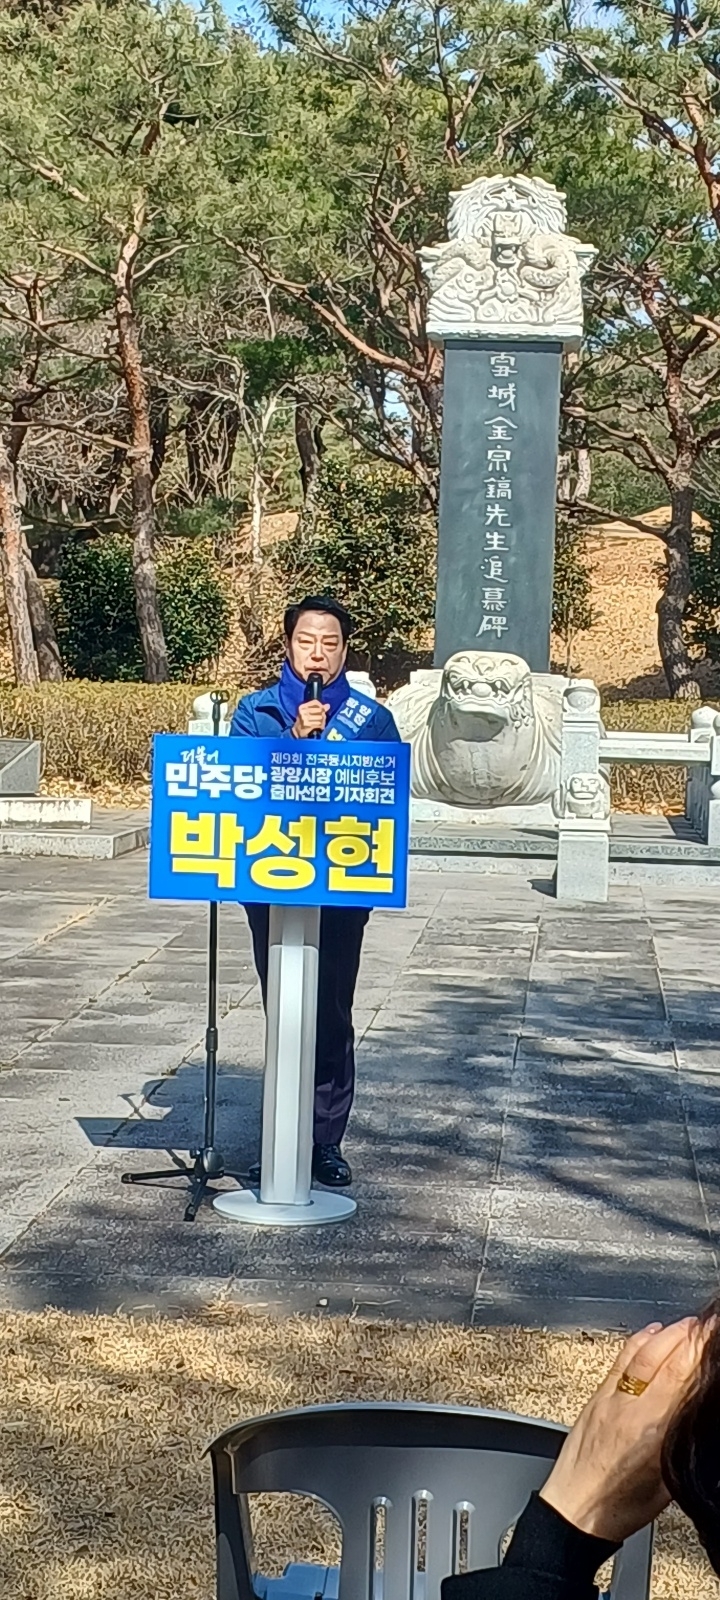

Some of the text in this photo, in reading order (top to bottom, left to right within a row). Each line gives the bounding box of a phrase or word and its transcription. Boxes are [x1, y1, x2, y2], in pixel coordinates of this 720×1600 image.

[180, 745, 218, 765] 더불어
[271, 752, 396, 769] 제9회 전국동시지방선거
[165, 763, 268, 799] 민주당
[270, 766, 396, 786] 광양시장 예비후보
[270, 784, 396, 805] 출마선언 기자회견
[170, 811, 395, 893] 박성현
